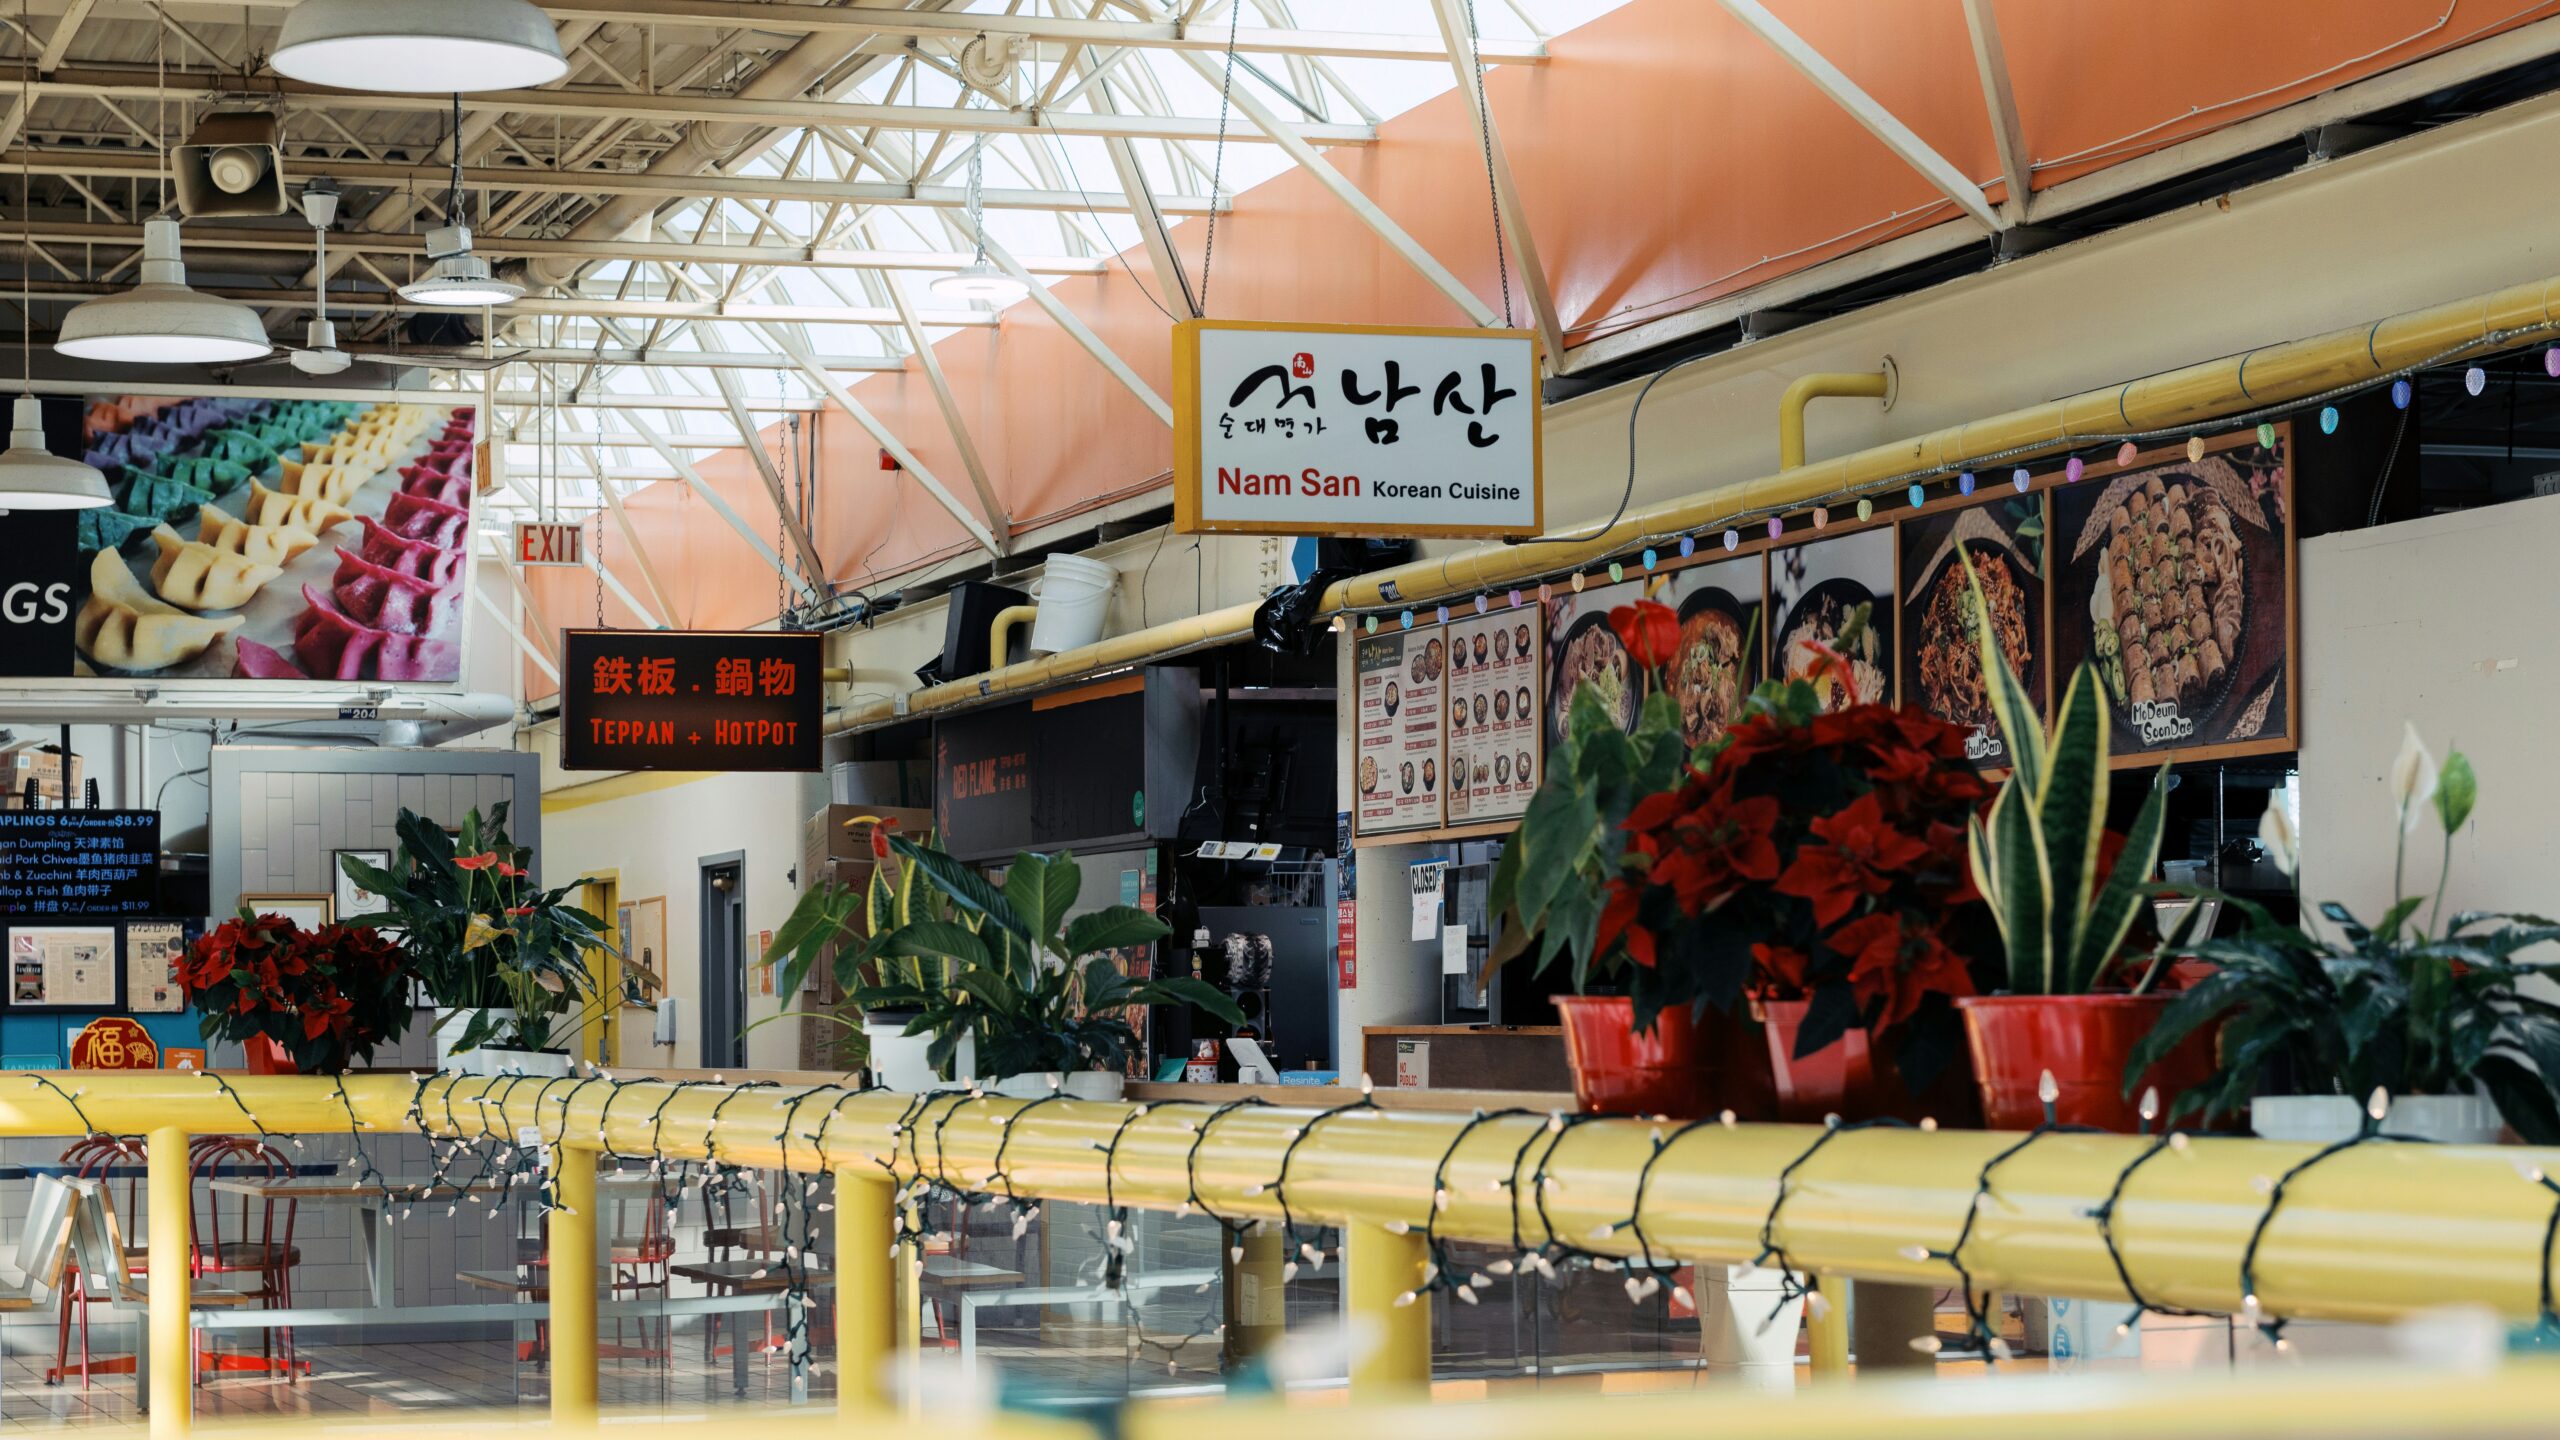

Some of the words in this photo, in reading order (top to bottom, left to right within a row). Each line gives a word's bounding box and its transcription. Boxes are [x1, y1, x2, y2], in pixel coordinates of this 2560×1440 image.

[1341, 360, 1517, 448] 남산
[1218, 467, 1291, 495] Nam
[1301, 468, 1360, 496] San
[1373, 481, 1442, 499] Korean
[1449, 483, 1520, 500] Cuisine
[523, 525, 580, 562] EXIT
[2, 582, 71, 624] GS
[715, 657, 796, 697] 鍋物
[352, 709, 376, 719] 204
[590, 718, 674, 745] TEPPAN
[688, 731, 701, 745] +
[1963, 737, 2001, 756] hulPan
[969, 758, 996, 797] FLAME
[19, 839, 71, 851] Dumpling
[15, 854, 39, 864] Pork
[14, 870, 22, 880] &
[26, 869, 72, 880] Zucchini
[1412, 865, 1437, 895] CLOSED
[0, 885, 22, 898] llop
[25, 886, 33, 896] &
[37, 885, 58, 896] Fish
[62, 885, 111, 897] 鱼肉带子
[86, 1026, 125, 1067] 福
[1399, 1063, 1407, 1073] NO
[1399, 1075, 1418, 1087] PUBLIC
